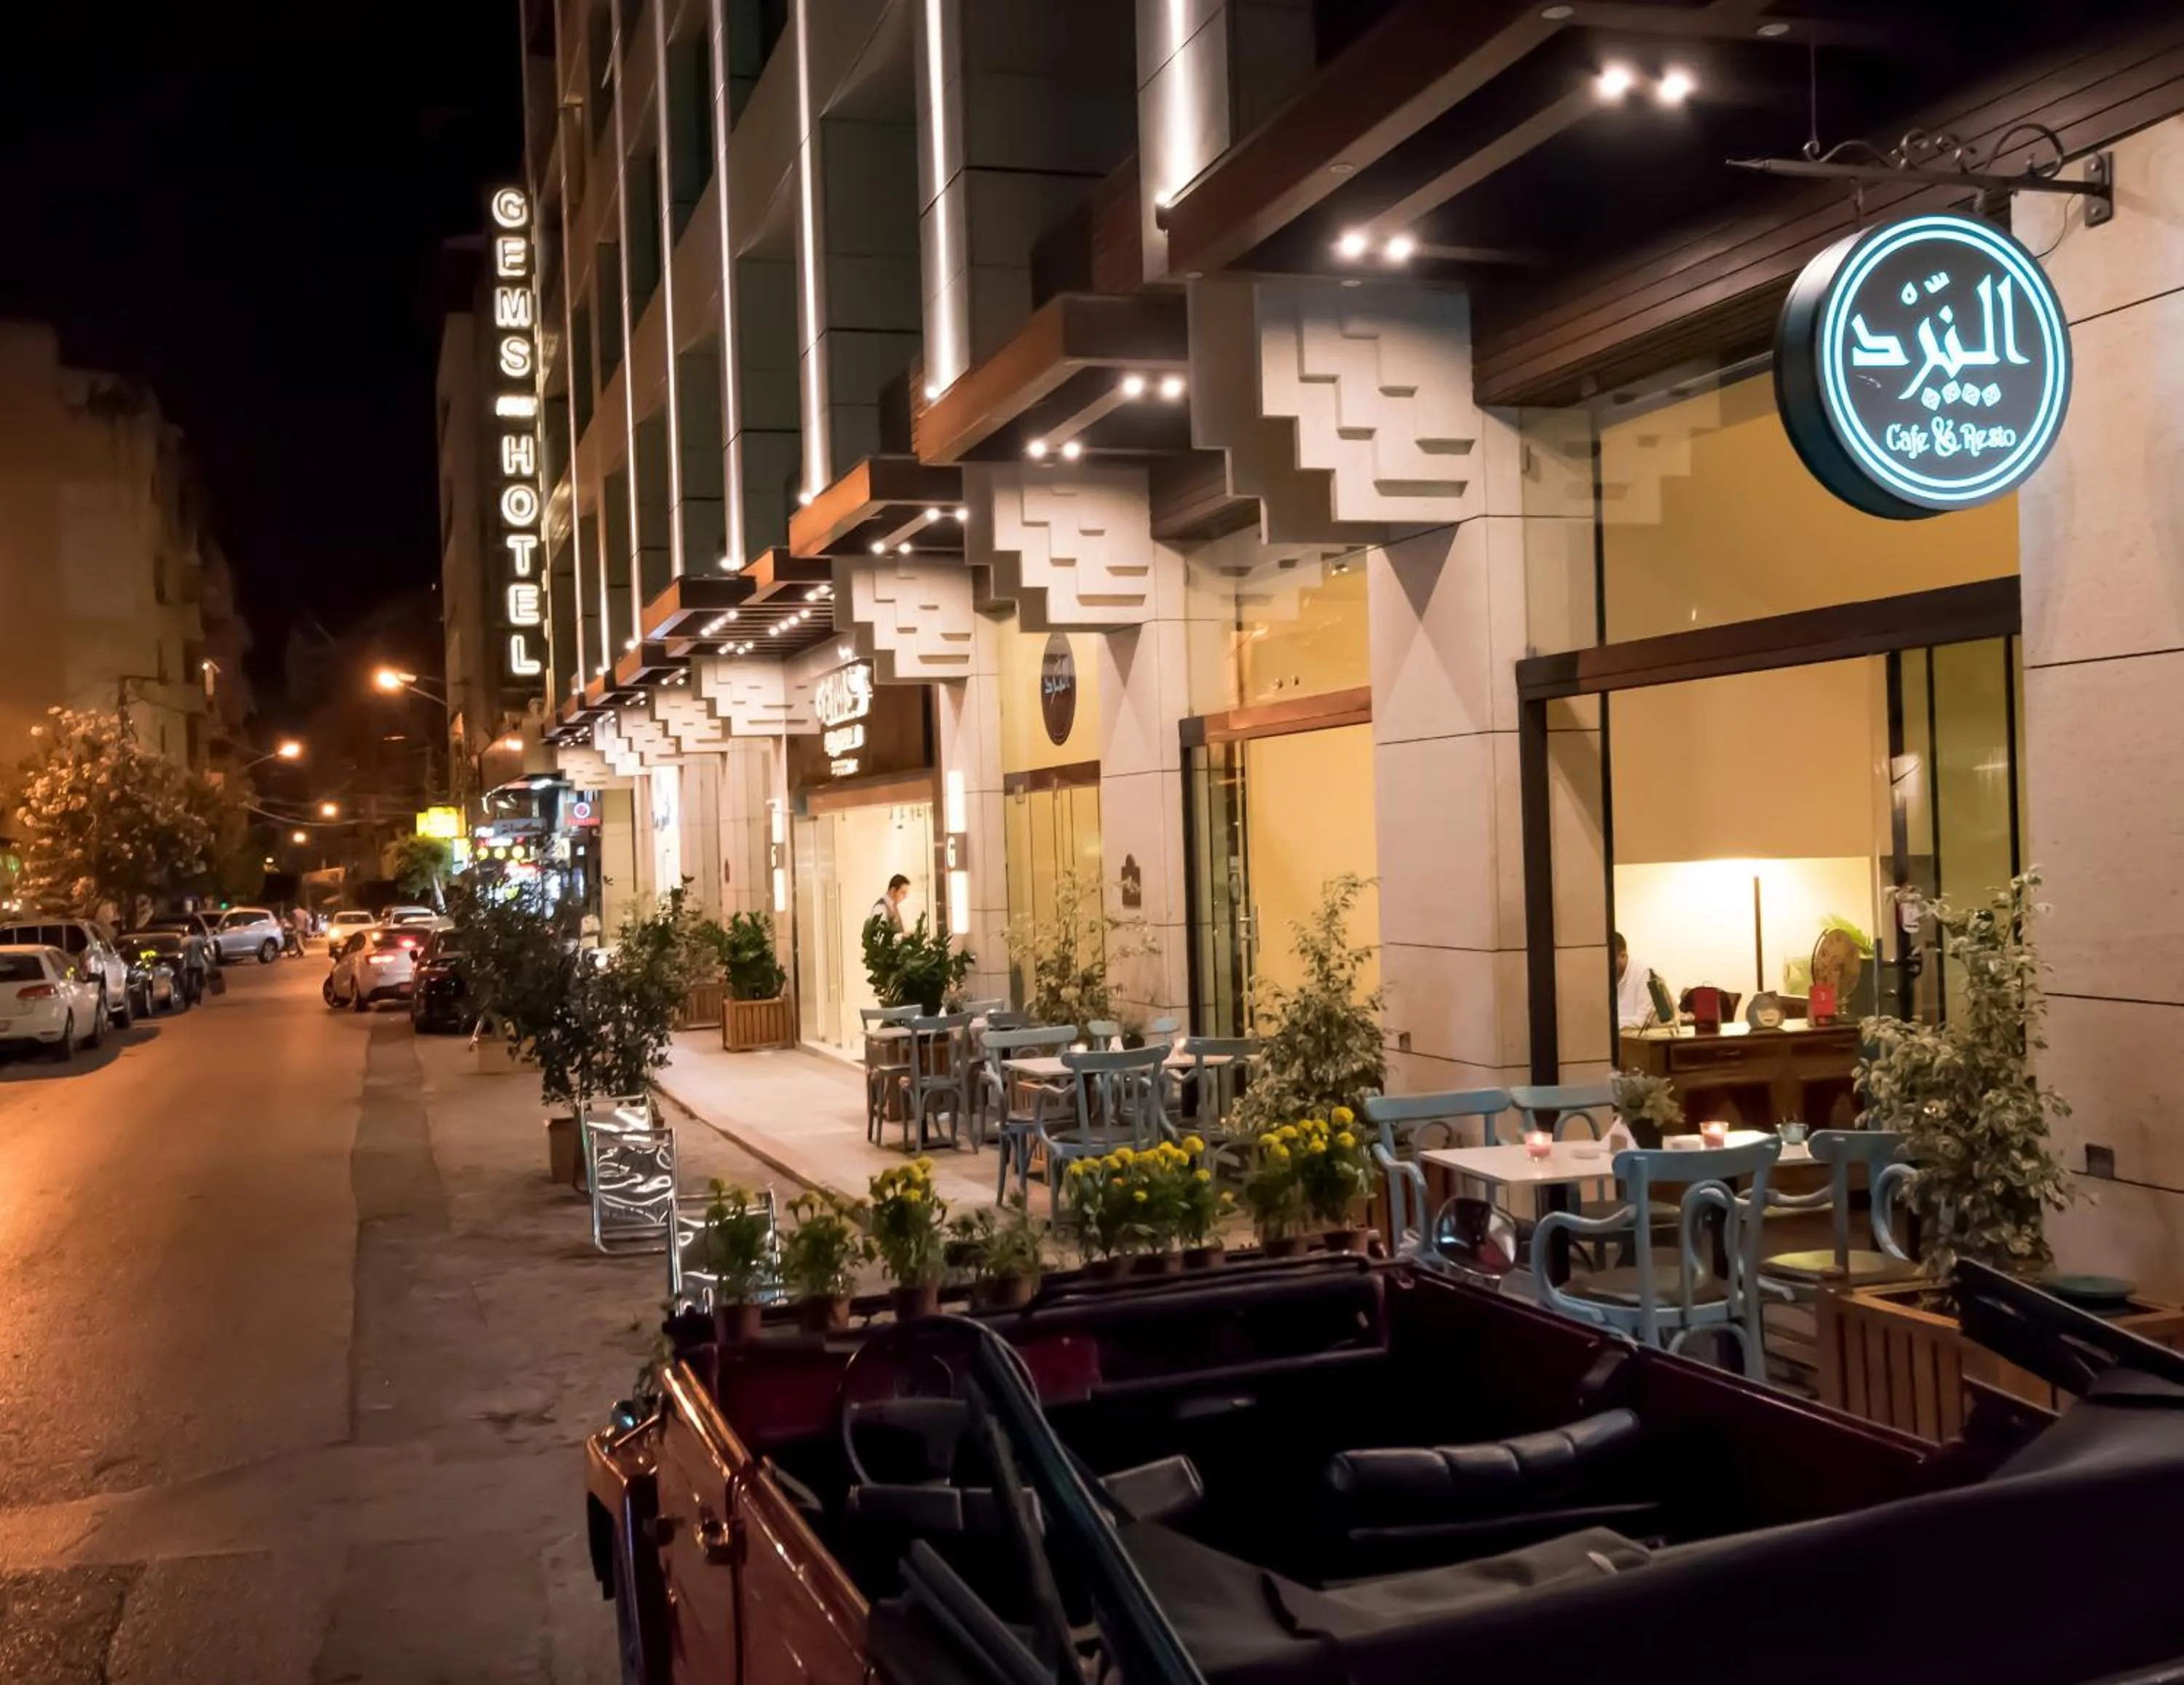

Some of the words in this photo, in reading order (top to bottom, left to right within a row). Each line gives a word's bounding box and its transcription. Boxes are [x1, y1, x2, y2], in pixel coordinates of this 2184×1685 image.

[1886, 424, 1930, 459] Cafe
[1931, 416, 1961, 457] &
[1959, 422, 2017, 457] Resto
